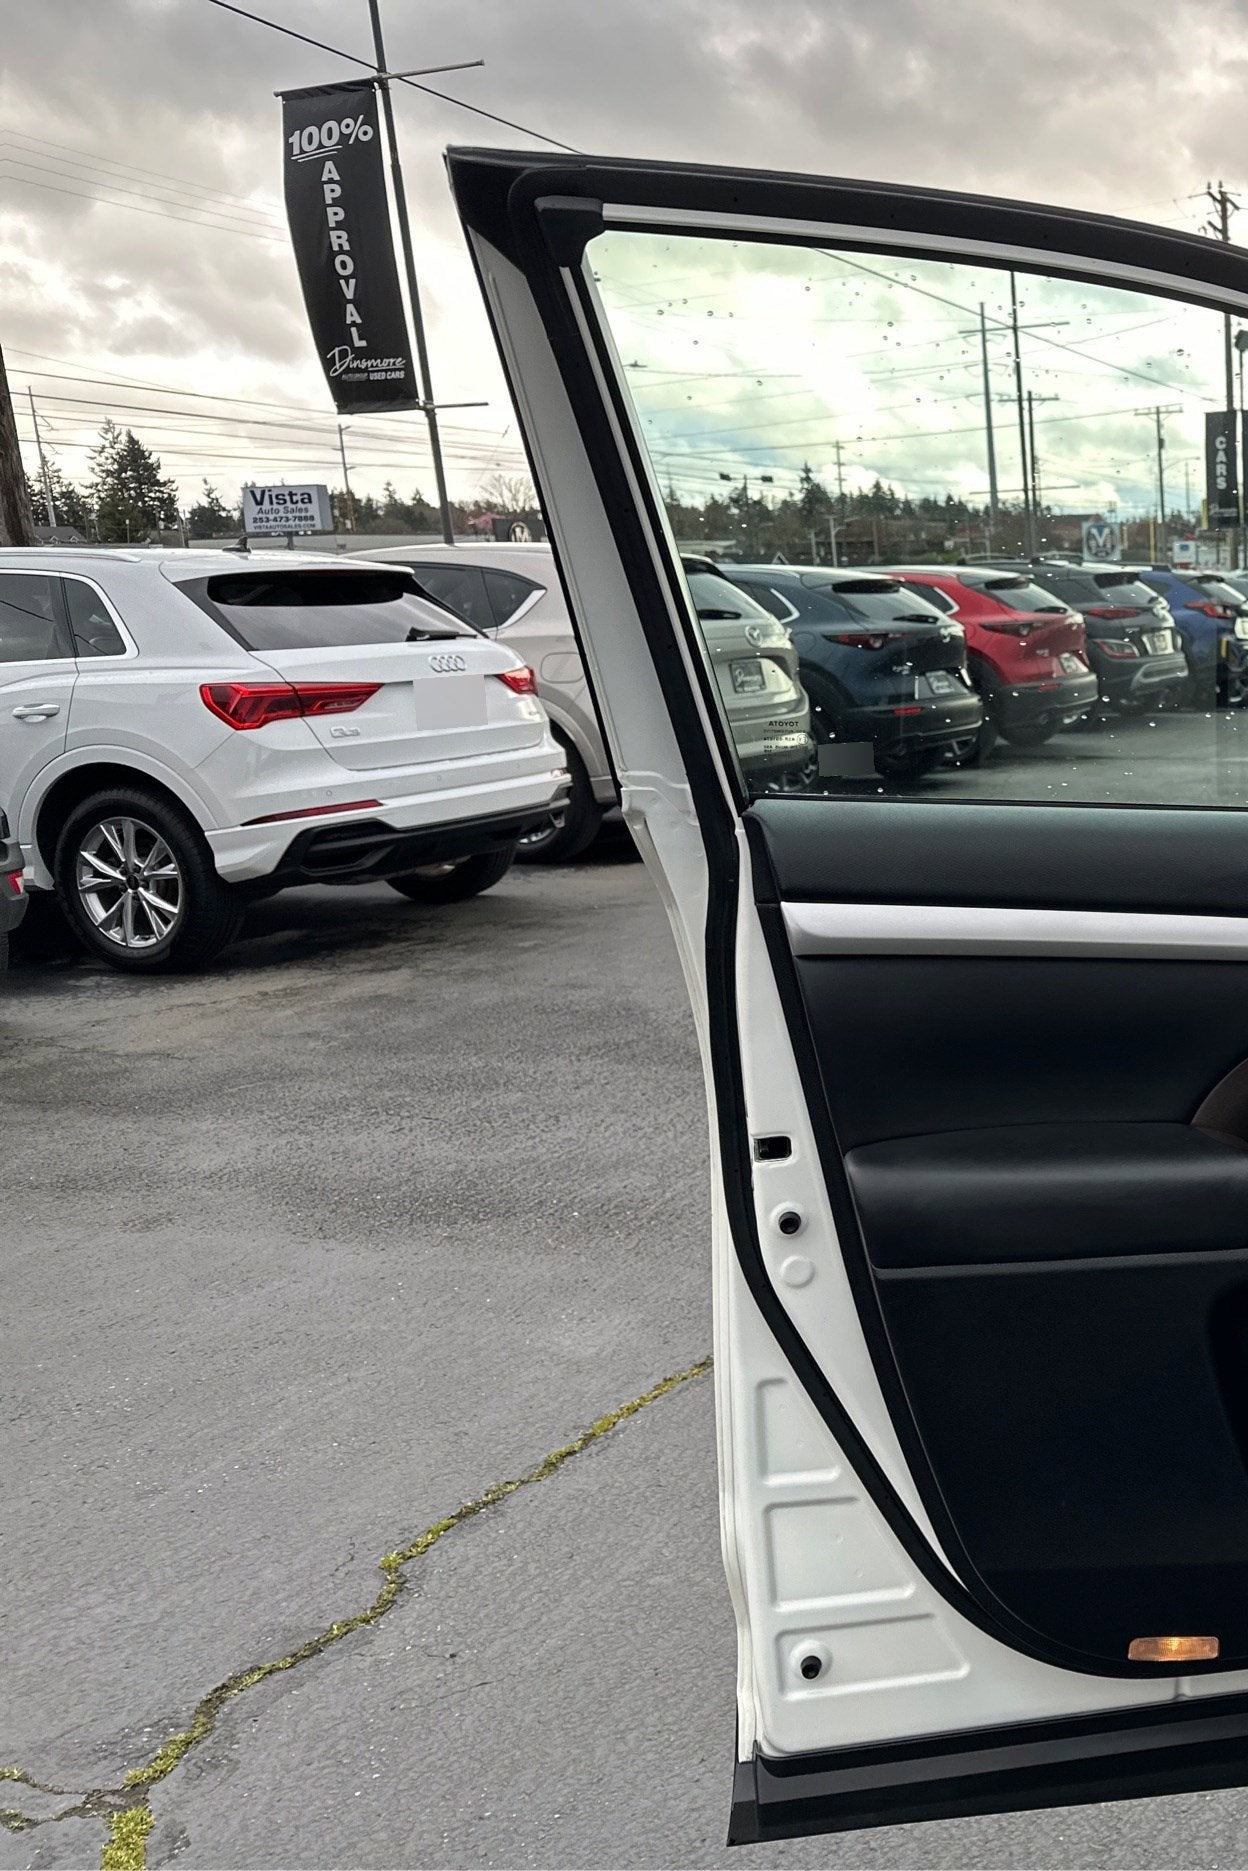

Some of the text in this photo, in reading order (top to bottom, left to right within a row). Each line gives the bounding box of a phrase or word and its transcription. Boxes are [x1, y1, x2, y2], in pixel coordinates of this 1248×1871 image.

[288, 114, 374, 155] 100%
[321, 160, 368, 348] APPROVAL
[326, 345, 406, 377] Dinsmore
[369, 371, 386, 380] USED
[386, 370, 405, 379] CARS
[1215, 435, 1227, 490] CARS
[249, 489, 313, 506] Vista
[256, 505, 309, 515] Auto Sales
